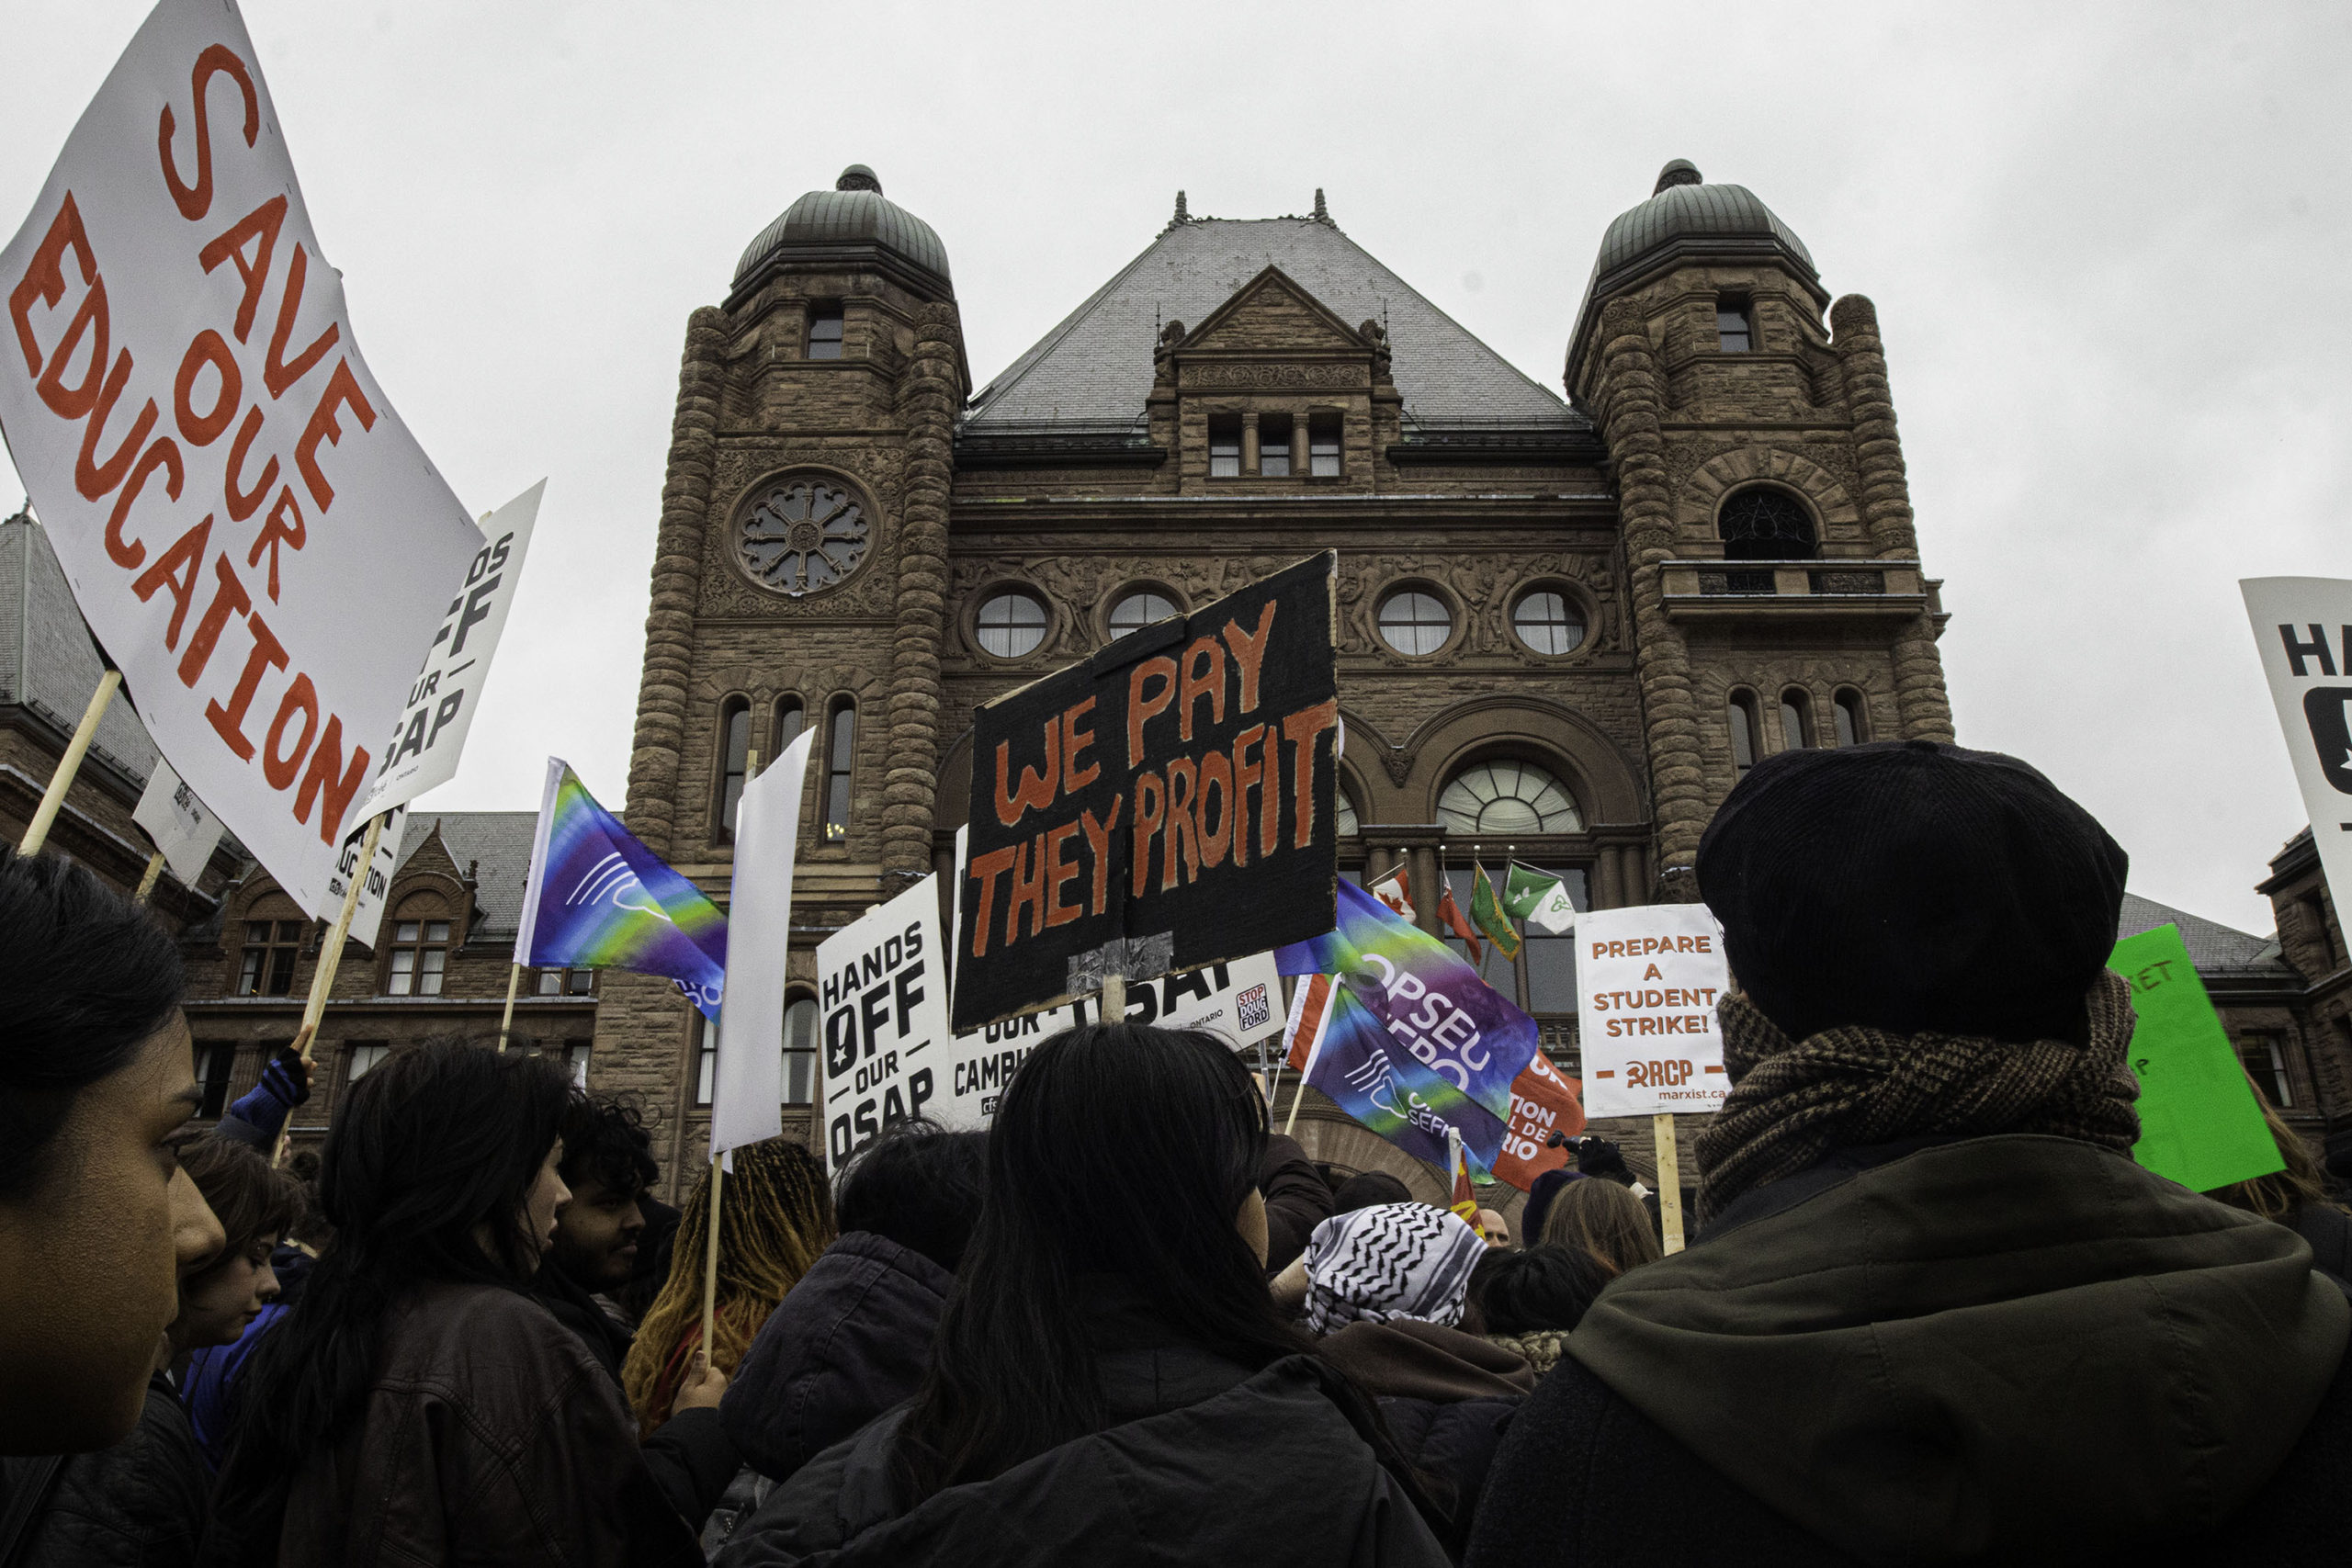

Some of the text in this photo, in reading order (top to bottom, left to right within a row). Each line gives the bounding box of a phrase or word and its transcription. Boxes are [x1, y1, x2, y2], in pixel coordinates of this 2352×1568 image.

[159, 44, 377, 514] SAVE
[174, 328, 306, 605] OUR
[9, 188, 370, 848] EDUCATION
[406, 670, 442, 709] UR
[995, 600, 1276, 824] WE PAY
[970, 700, 1337, 958] THEY PROFIT
[1592, 935, 1713, 960] PREPARE
[822, 920, 922, 1012] HANDS
[1644, 964, 1663, 981] A
[1238, 986, 1264, 1006] STOP
[1239, 997, 1266, 1018] DOUG
[1594, 987, 1717, 1011] STUDENT
[826, 959, 925, 1079] OFF
[1190, 1009, 1223, 1029] ONTARIO
[1241, 1010, 1268, 1030] FORD
[1607, 1015, 1709, 1037] STRIKE!
[855, 1050, 899, 1095] OUR
[955, 1046, 1032, 1097] CAMP
[1649, 1060, 1693, 1087] RCP
[1658, 1089, 1726, 1100] marxist.ca
[831, 1066, 933, 1168] OSAP
[1408, 1109, 1450, 1138] SEF
[1521, 1122, 1549, 1143] DE
